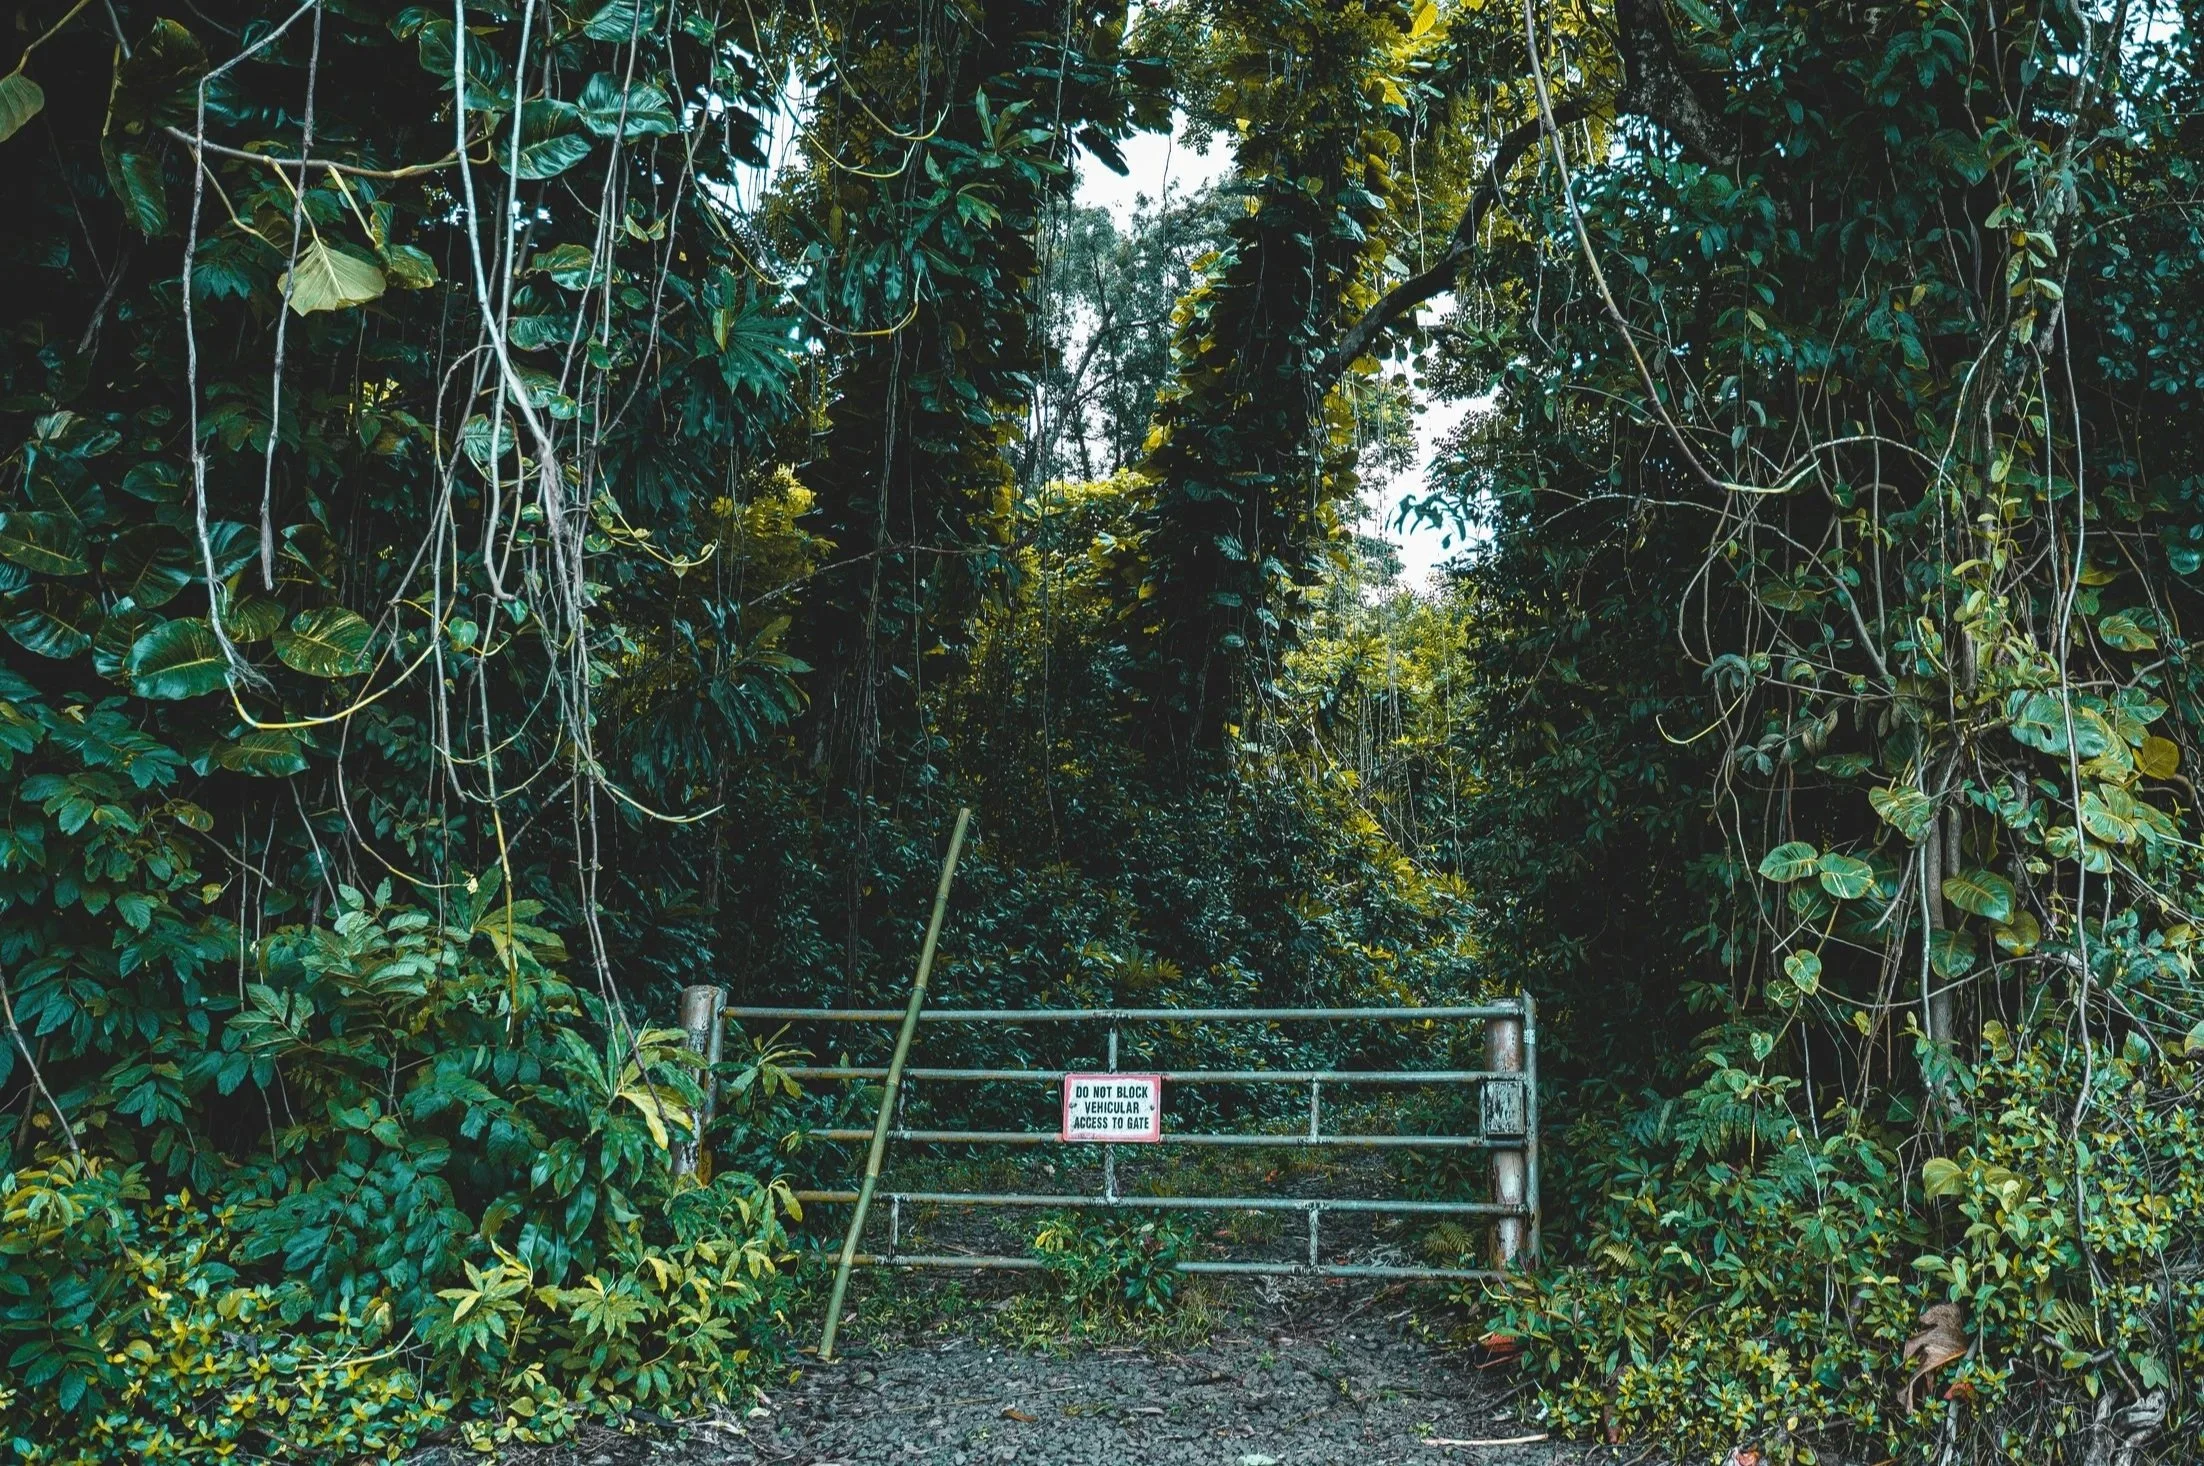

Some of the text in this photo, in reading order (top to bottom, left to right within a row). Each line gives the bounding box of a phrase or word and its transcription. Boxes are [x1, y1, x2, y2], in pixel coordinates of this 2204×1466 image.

[1076, 1086, 1148, 1098] DO NOT BLOCK
[1085, 1102, 1139, 1114] VEHICULAR
[1074, 1117, 1149, 1129] ACCESS TO GATE
